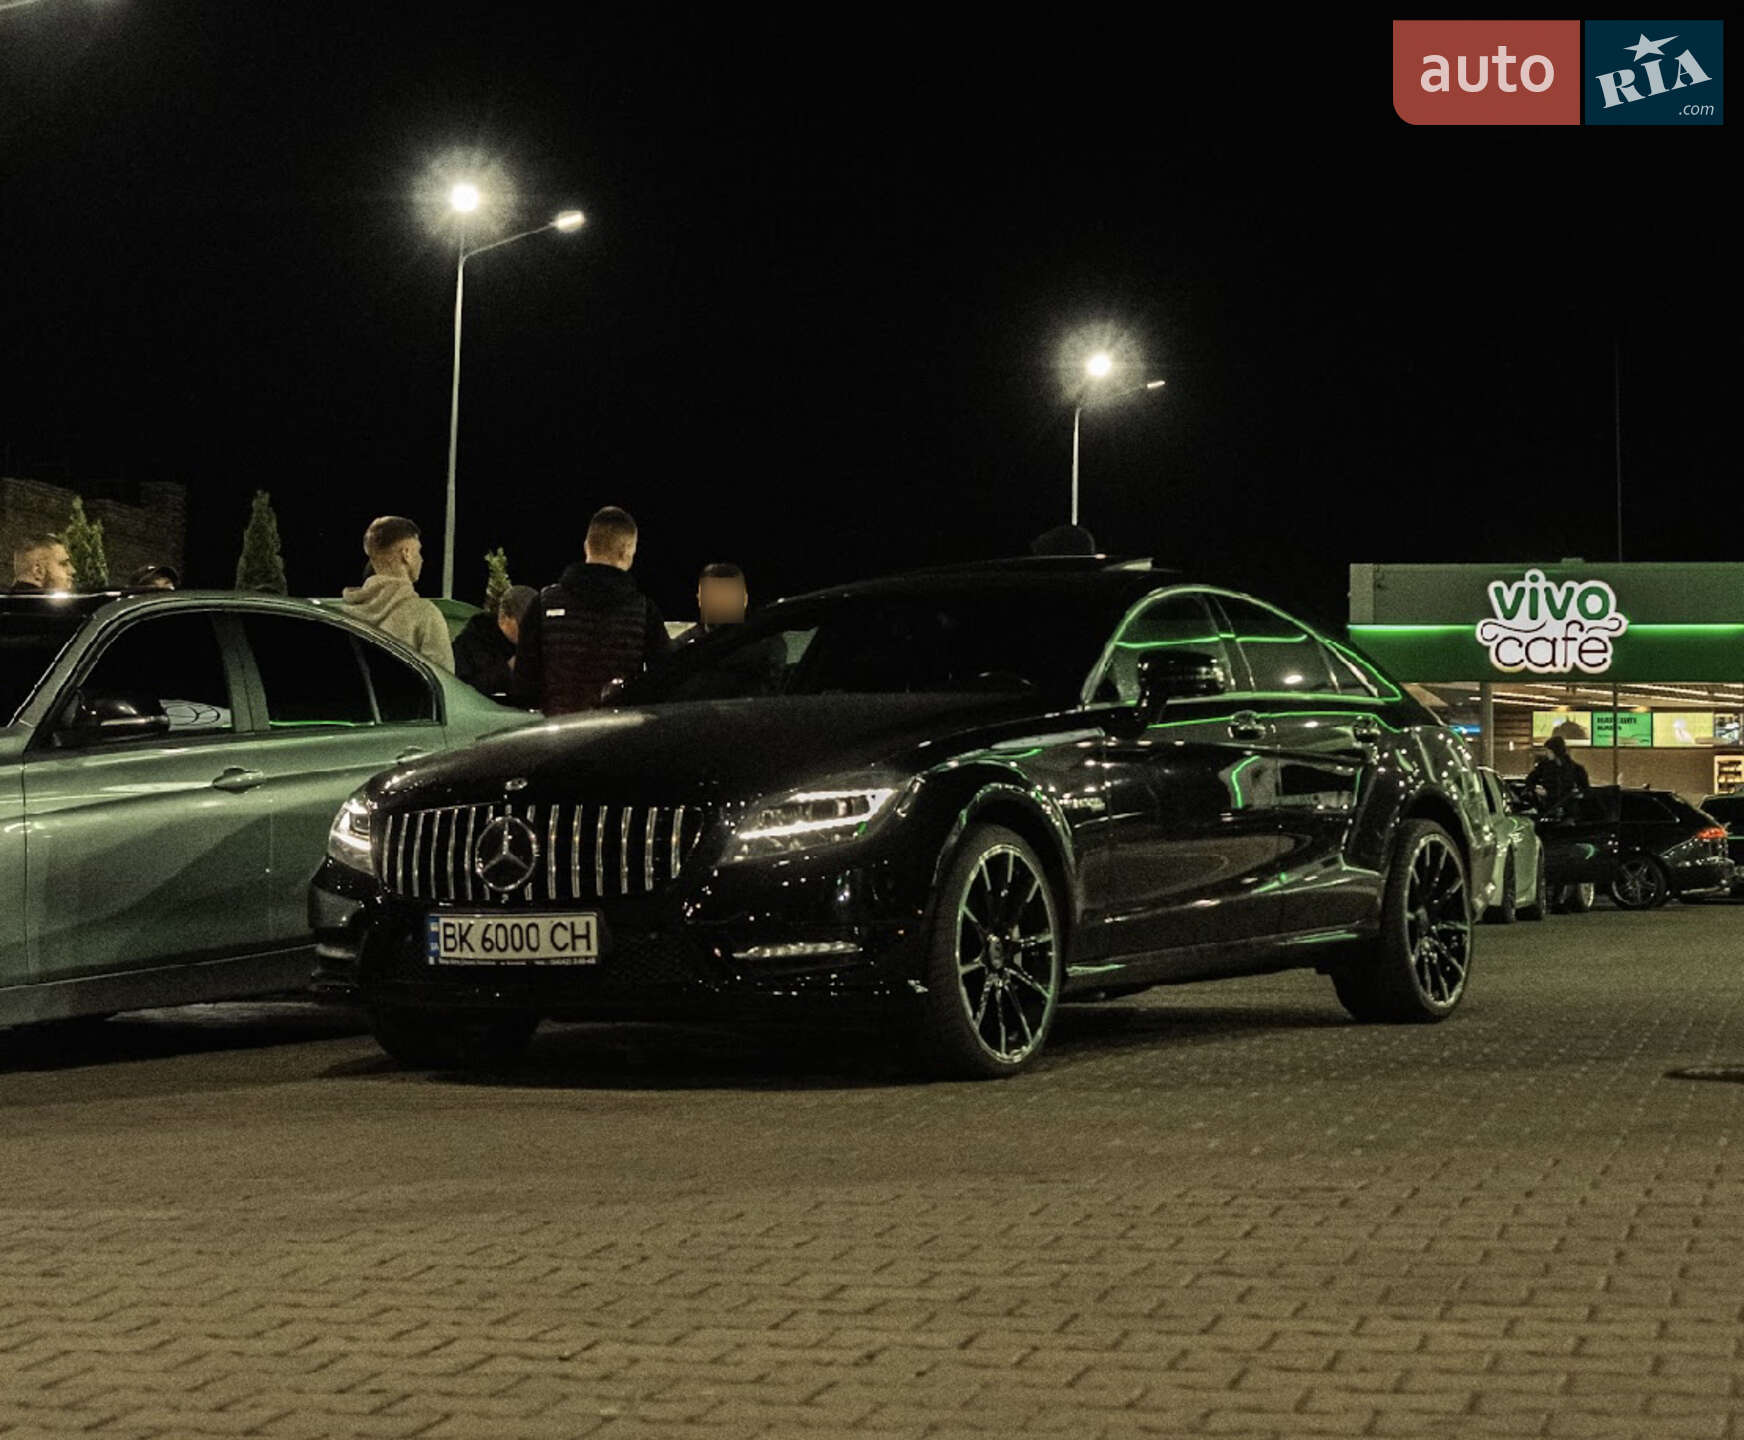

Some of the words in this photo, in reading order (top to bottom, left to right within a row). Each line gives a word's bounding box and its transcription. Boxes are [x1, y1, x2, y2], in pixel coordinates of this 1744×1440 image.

[1493, 573, 1611, 621] vivo
[443, 923, 475, 953] BK
[481, 921, 540, 953] 6000
[550, 920, 592, 952] CH
